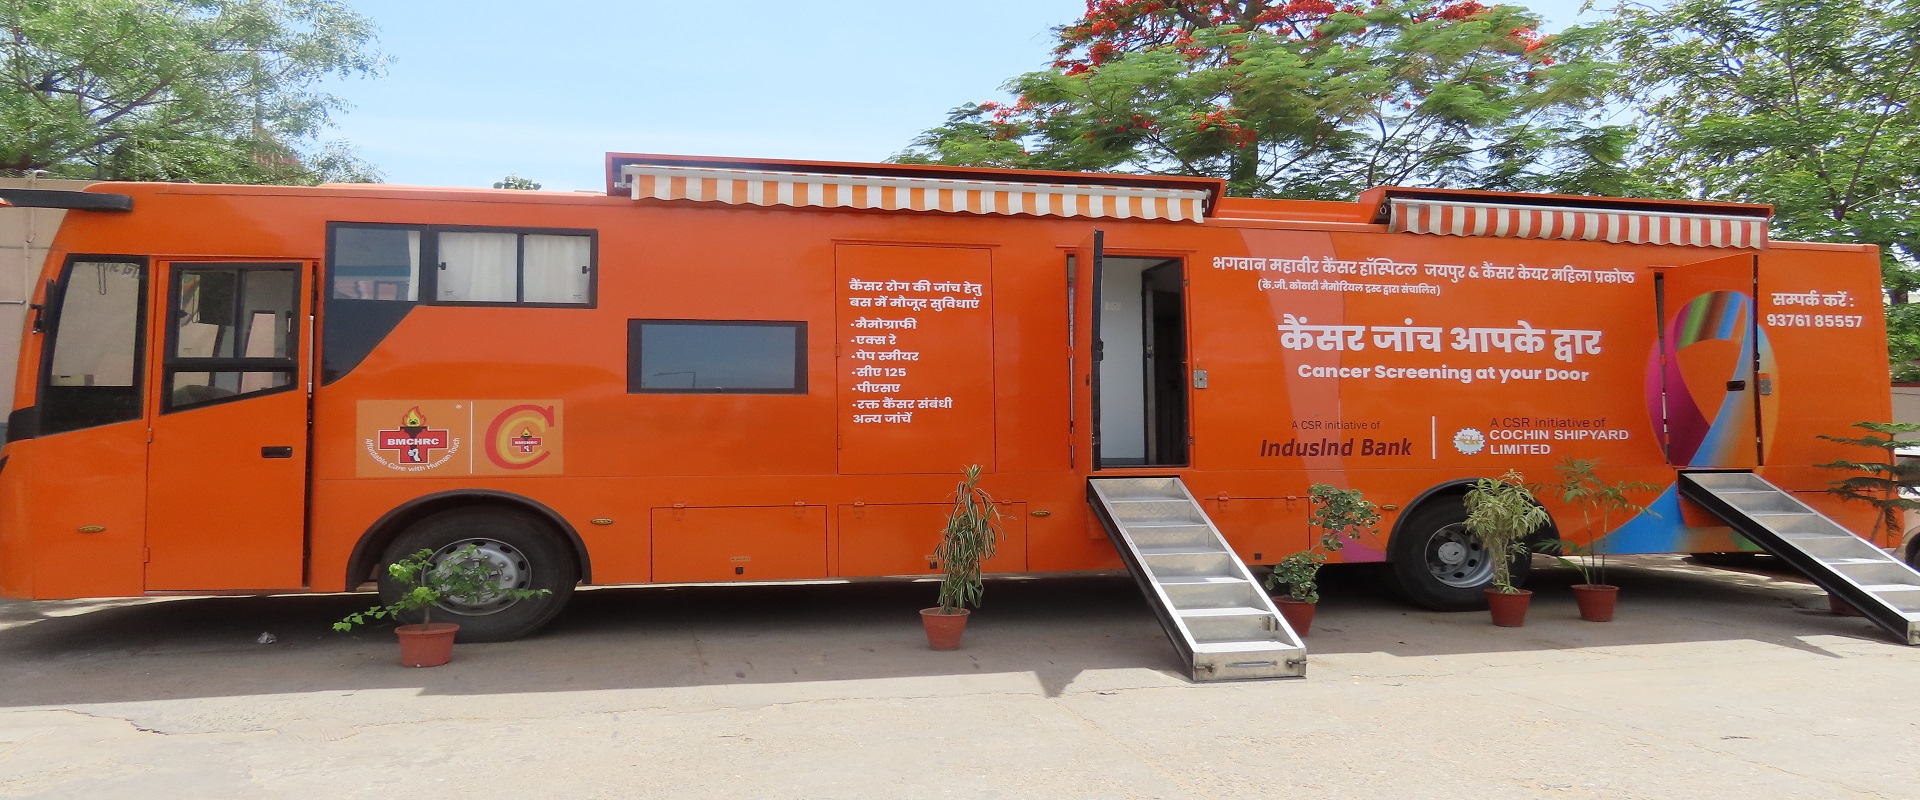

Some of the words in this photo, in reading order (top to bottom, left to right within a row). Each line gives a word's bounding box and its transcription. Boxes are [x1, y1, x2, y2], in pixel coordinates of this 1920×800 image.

[1213, 256, 1267, 271] भगवान
[1270, 256, 1319, 274] महावीर
[1322, 256, 1357, 274] कैंसर
[1359, 257, 1417, 276] हॉस्पिटल
[1424, 263, 1465, 283] जयपुर
[1468, 266, 1479, 278] &
[1482, 261, 1514, 280] कैंसर
[1517, 264, 1549, 281] केयर
[1551, 265, 1592, 283] महिला
[1594, 268, 1635, 284] प्रकोष्ठ
[849, 278, 883, 291] कैंसर
[885, 280, 909, 291] रोग
[912, 280, 931, 292] की
[934, 281, 961, 293] जांच
[963, 281, 982, 296] हेतु
[1258, 278, 1288, 291] (के.जी.
[1290, 279, 1319, 291] कोठारी
[1320, 280, 1363, 292] मैमोरियल
[1365, 283, 1381, 294] ट्रस्ट
[1383, 284, 1399, 295] द्वारा
[1401, 282, 1440, 296] संचालित)
[849, 297, 872, 307] बस
[874, 296, 888, 307] में
[890, 295, 927, 311] मौजूद
[930, 296, 979, 311] सुविधाएं
[1771, 290, 1820, 306] सम्पर्क
[1822, 291, 1847, 307] करें
[855, 317, 917, 329] मैमोग्राफी
[1766, 314, 1810, 327] 93761
[1815, 315, 1863, 327] 85557
[856, 335, 886, 345] एक्स
[888, 334, 896, 345] रे
[1278, 313, 1365, 351] कैंसर
[1371, 318, 1442, 352] जांच
[1450, 320, 1545, 354] आपके
[1551, 329, 1601, 363] द्वार
[856, 349, 875, 361] पेप
[878, 349, 919, 361] स्मीयर
[856, 365, 882, 377] सीए
[885, 368, 906, 377] 125
[1298, 364, 1370, 379] Cancer
[1374, 364, 1472, 384] Screening
[1476, 366, 1495, 380] at
[1498, 367, 1541, 383] your
[1545, 368, 1589, 382] Door
[856, 381, 900, 393] पीएसए
[857, 399, 880, 409] रक्त
[882, 396, 915, 409] कैंसर
[917, 397, 953, 409] संबंधी
[853, 414, 882, 423] अन्य
[884, 412, 912, 423] जांचें
[1490, 418, 1498, 428] A
[1503, 418, 1530, 428] CSR
[1535, 418, 1589, 428] initiative
[1593, 417, 1606, 428] of
[1292, 421, 1298, 429] A
[1301, 421, 1322, 430] CSR
[1325, 420, 1367, 430] initiative
[1370, 420, 1380, 430] of
[1490, 429, 1549, 440] COCHIN
[1554, 430, 1629, 440] SHIPYARD
[387, 438, 439, 446] BMCHRC
[1261, 438, 1354, 456] IndusInd
[1361, 438, 1413, 456] Bank
[366, 438, 387, 465] Affordable
[388, 463, 406, 471] Care
[426, 455, 452, 469] Human
[448, 437, 460, 454] Touch
[1490, 444, 1551, 455] LIMITED
